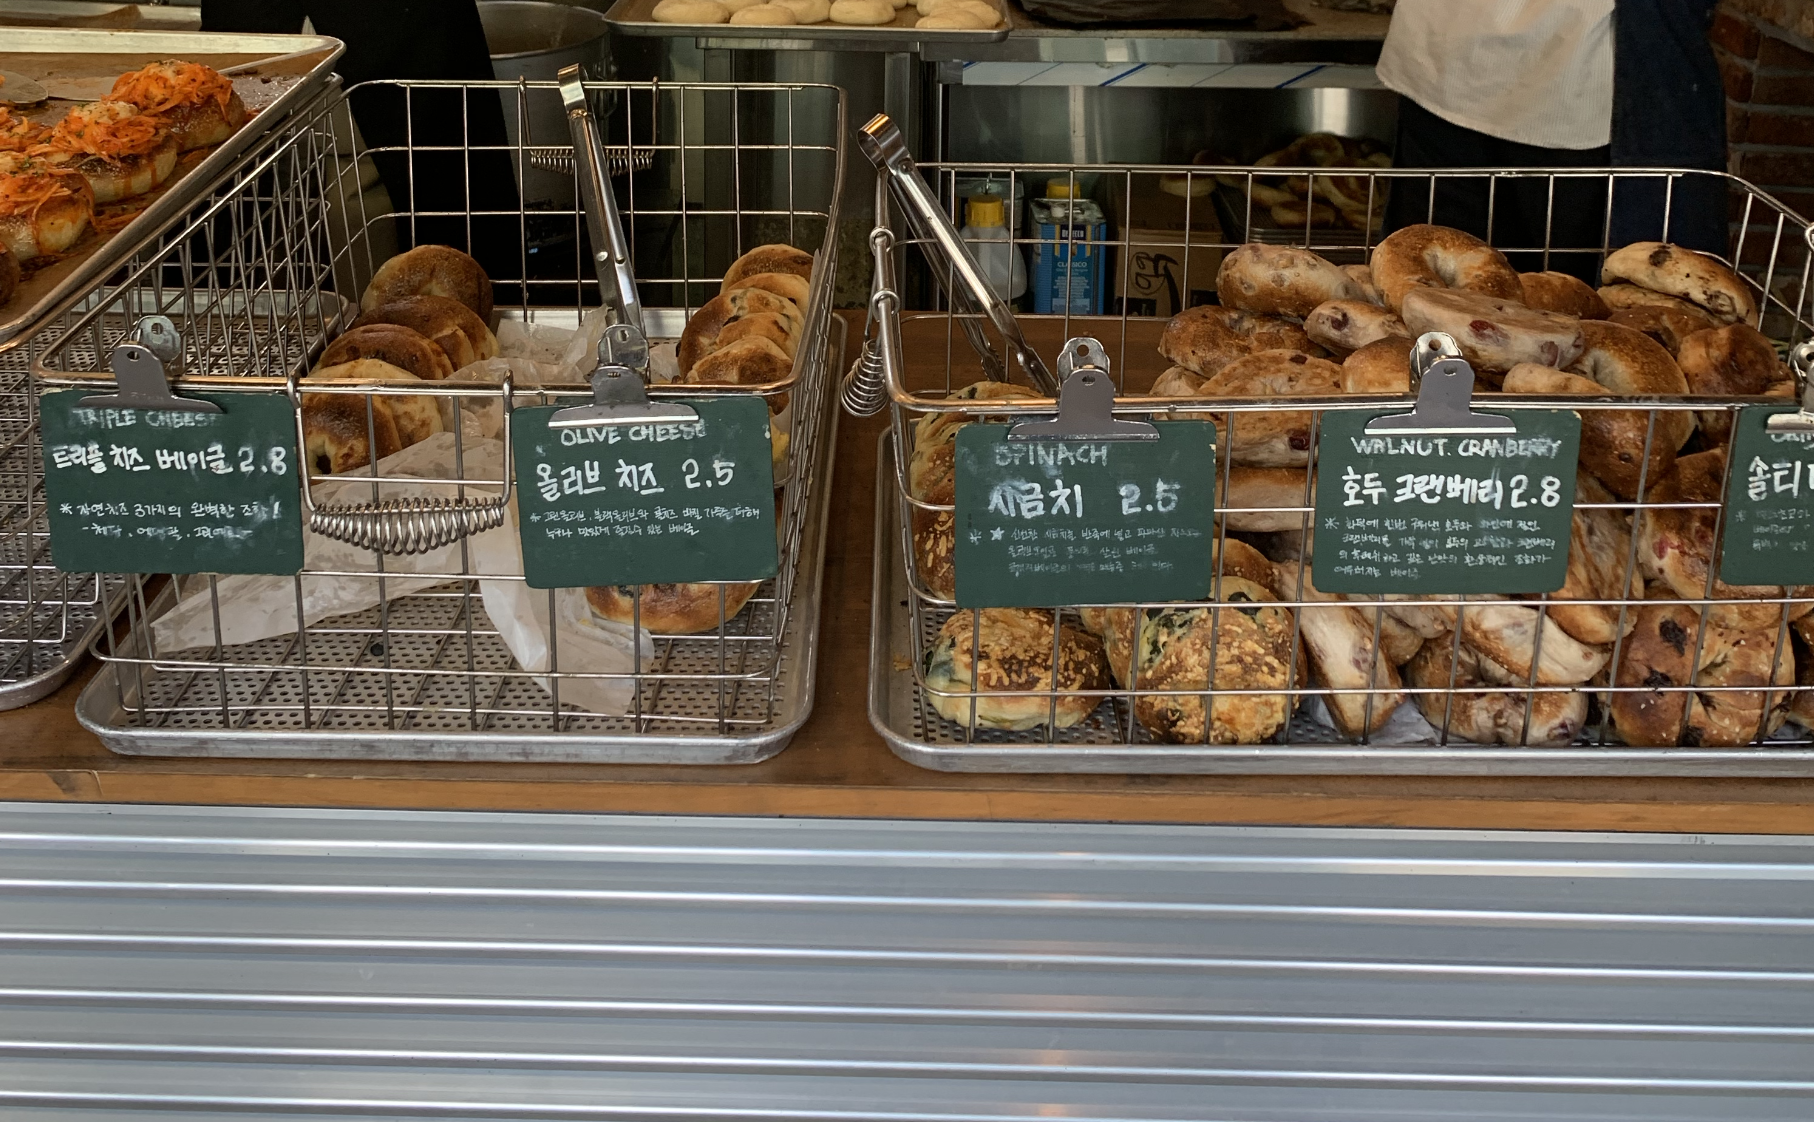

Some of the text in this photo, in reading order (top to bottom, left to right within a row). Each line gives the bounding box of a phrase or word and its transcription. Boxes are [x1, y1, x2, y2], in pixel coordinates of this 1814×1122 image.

[560, 419, 705, 446] OLIVE CHEESE
[53, 442, 288, 476] 트리플 치즈 베이글 2.8
[995, 443, 1107, 466] SPINACH
[1458, 437, 1562, 459] CRANBERRY
[537, 458, 736, 502] 올리브 치즈 2.5
[1342, 465, 1561, 510] 호두 크랜베리 2.8
[133, 503, 182, 518] 3가지의
[190, 502, 235, 518] 완벽한
[989, 478, 1181, 519] 시금치 2.5
[546, 527, 573, 540] 누구나
